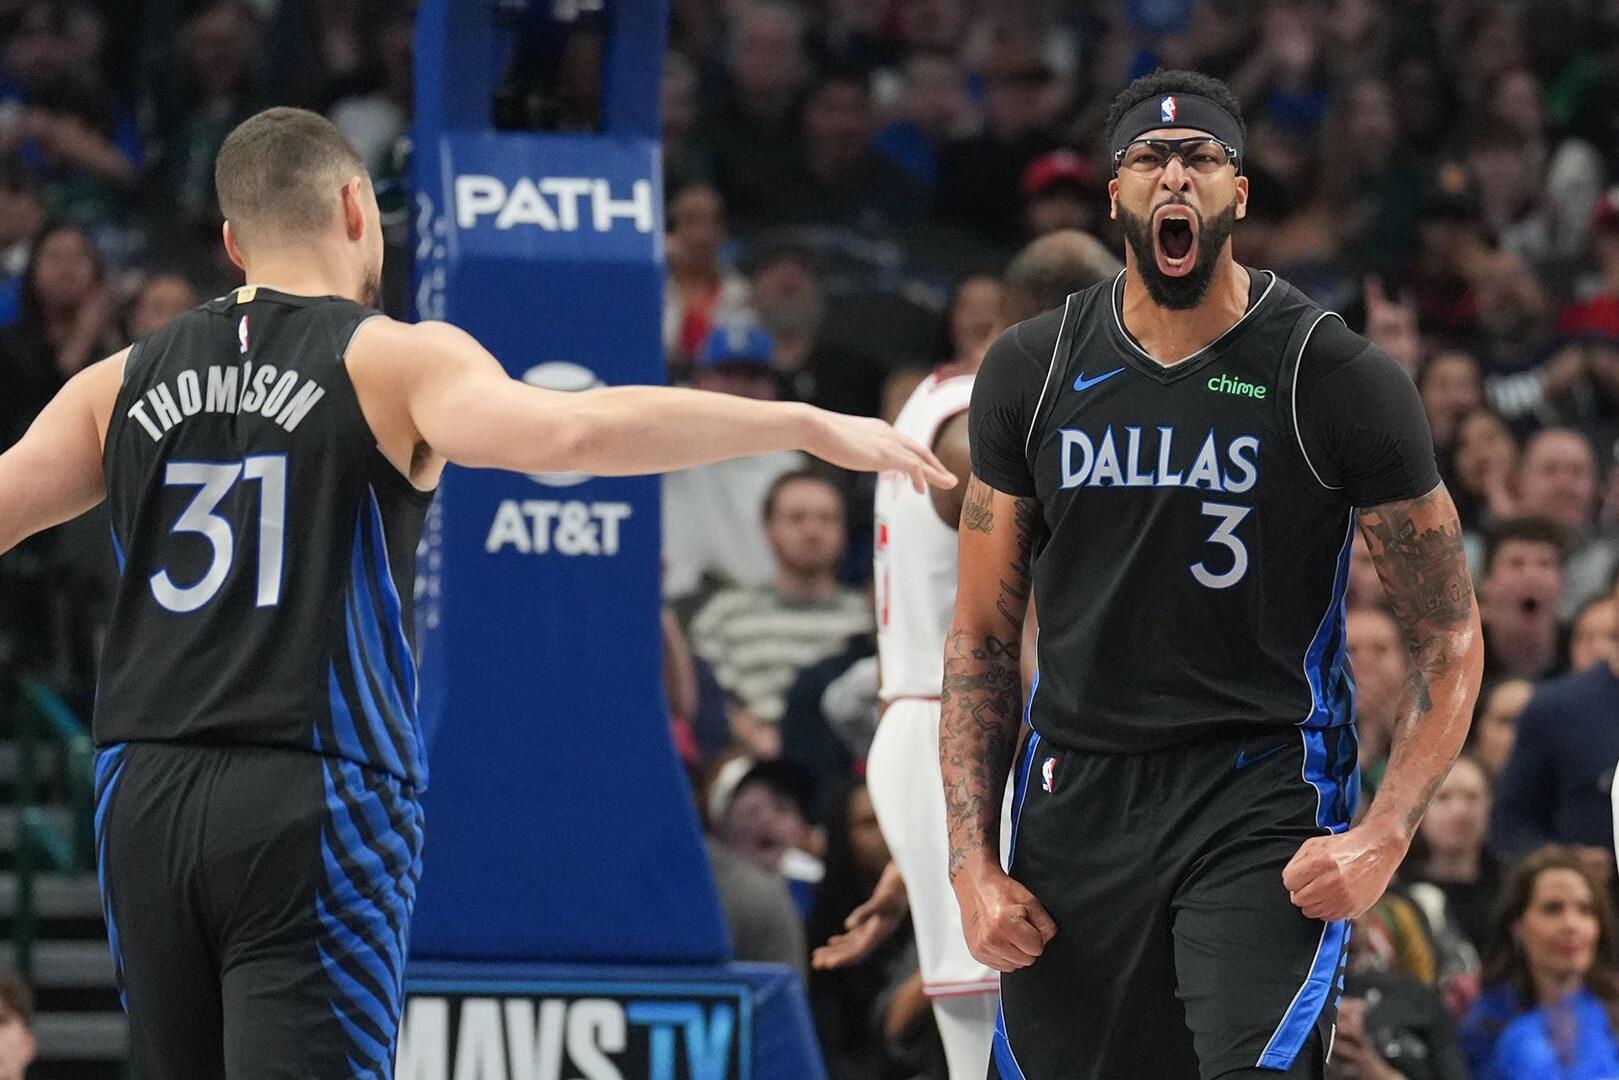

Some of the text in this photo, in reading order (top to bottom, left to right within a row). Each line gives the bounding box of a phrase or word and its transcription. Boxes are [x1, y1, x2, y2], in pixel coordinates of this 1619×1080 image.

[454, 174, 655, 233] PATH
[127, 360, 326, 442] THOMSON
[1207, 373, 1267, 399] chime
[1057, 424, 1260, 494] DALLAS
[148, 452, 288, 614] 31
[485, 499, 632, 557] AT&T
[1190, 501, 1252, 590] 3
